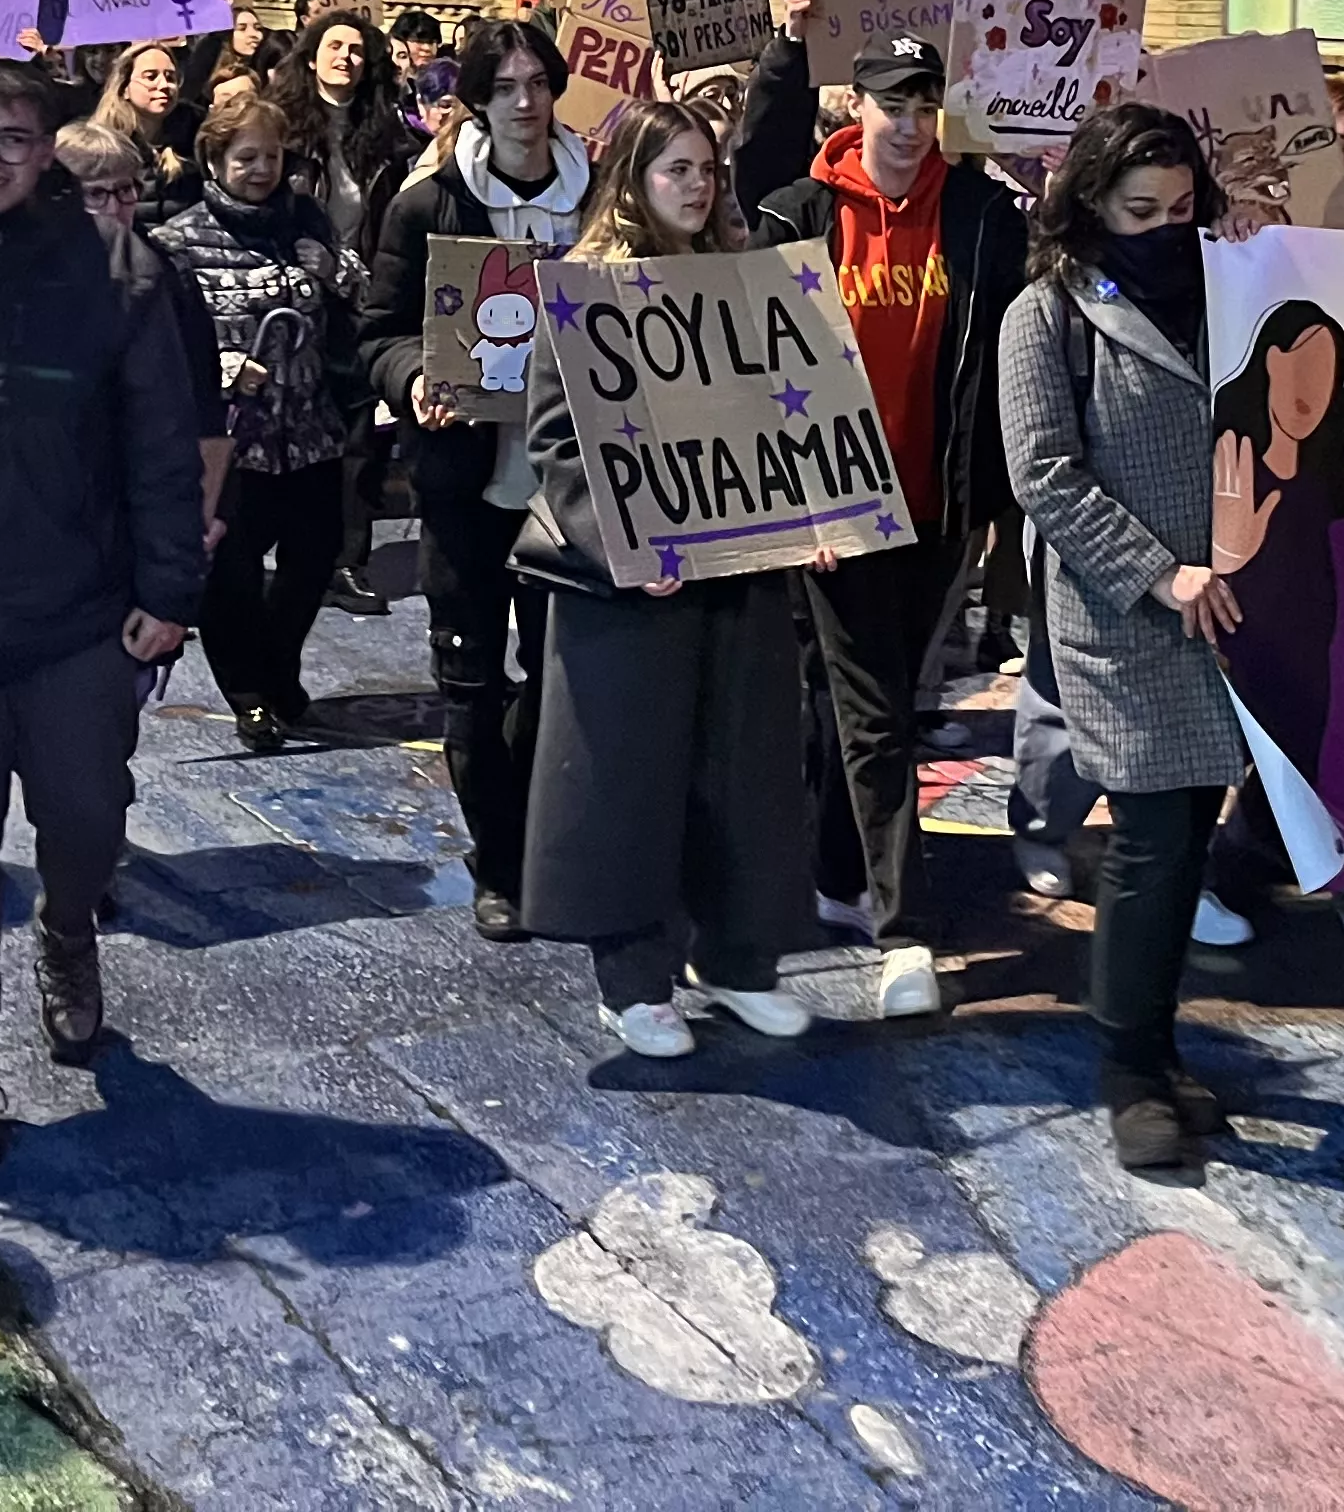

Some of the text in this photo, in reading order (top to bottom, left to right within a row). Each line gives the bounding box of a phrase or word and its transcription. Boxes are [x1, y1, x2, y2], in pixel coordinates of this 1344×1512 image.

[586, 292, 818, 402] SOY LA
[599, 407, 894, 551] PUTA AMA!
